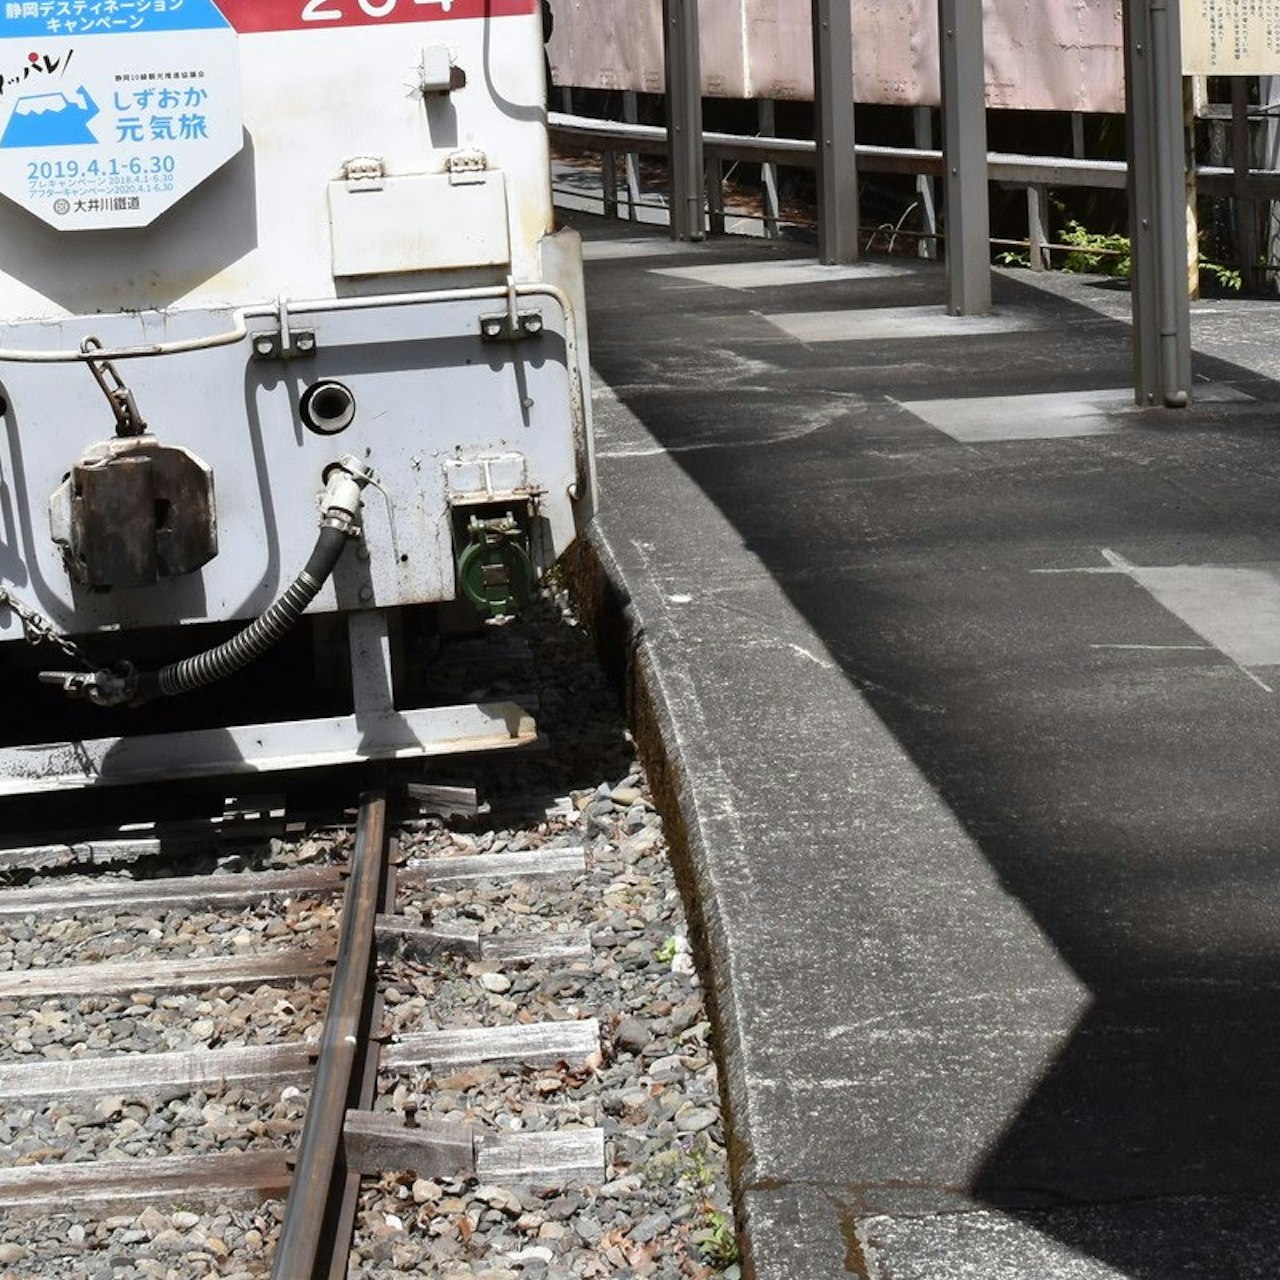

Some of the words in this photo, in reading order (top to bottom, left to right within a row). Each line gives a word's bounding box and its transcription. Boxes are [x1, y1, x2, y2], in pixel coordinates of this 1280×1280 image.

[46, 15, 144, 33] キャンペーン
[113, 85, 208, 111] しずおか
[115, 113, 209, 143] 元気旅
[26, 155, 175, 180] 2019.4.1-6.30
[29, 178, 106, 189] プレキャンペーン
[73, 196, 140, 213] 大井川鐵道
